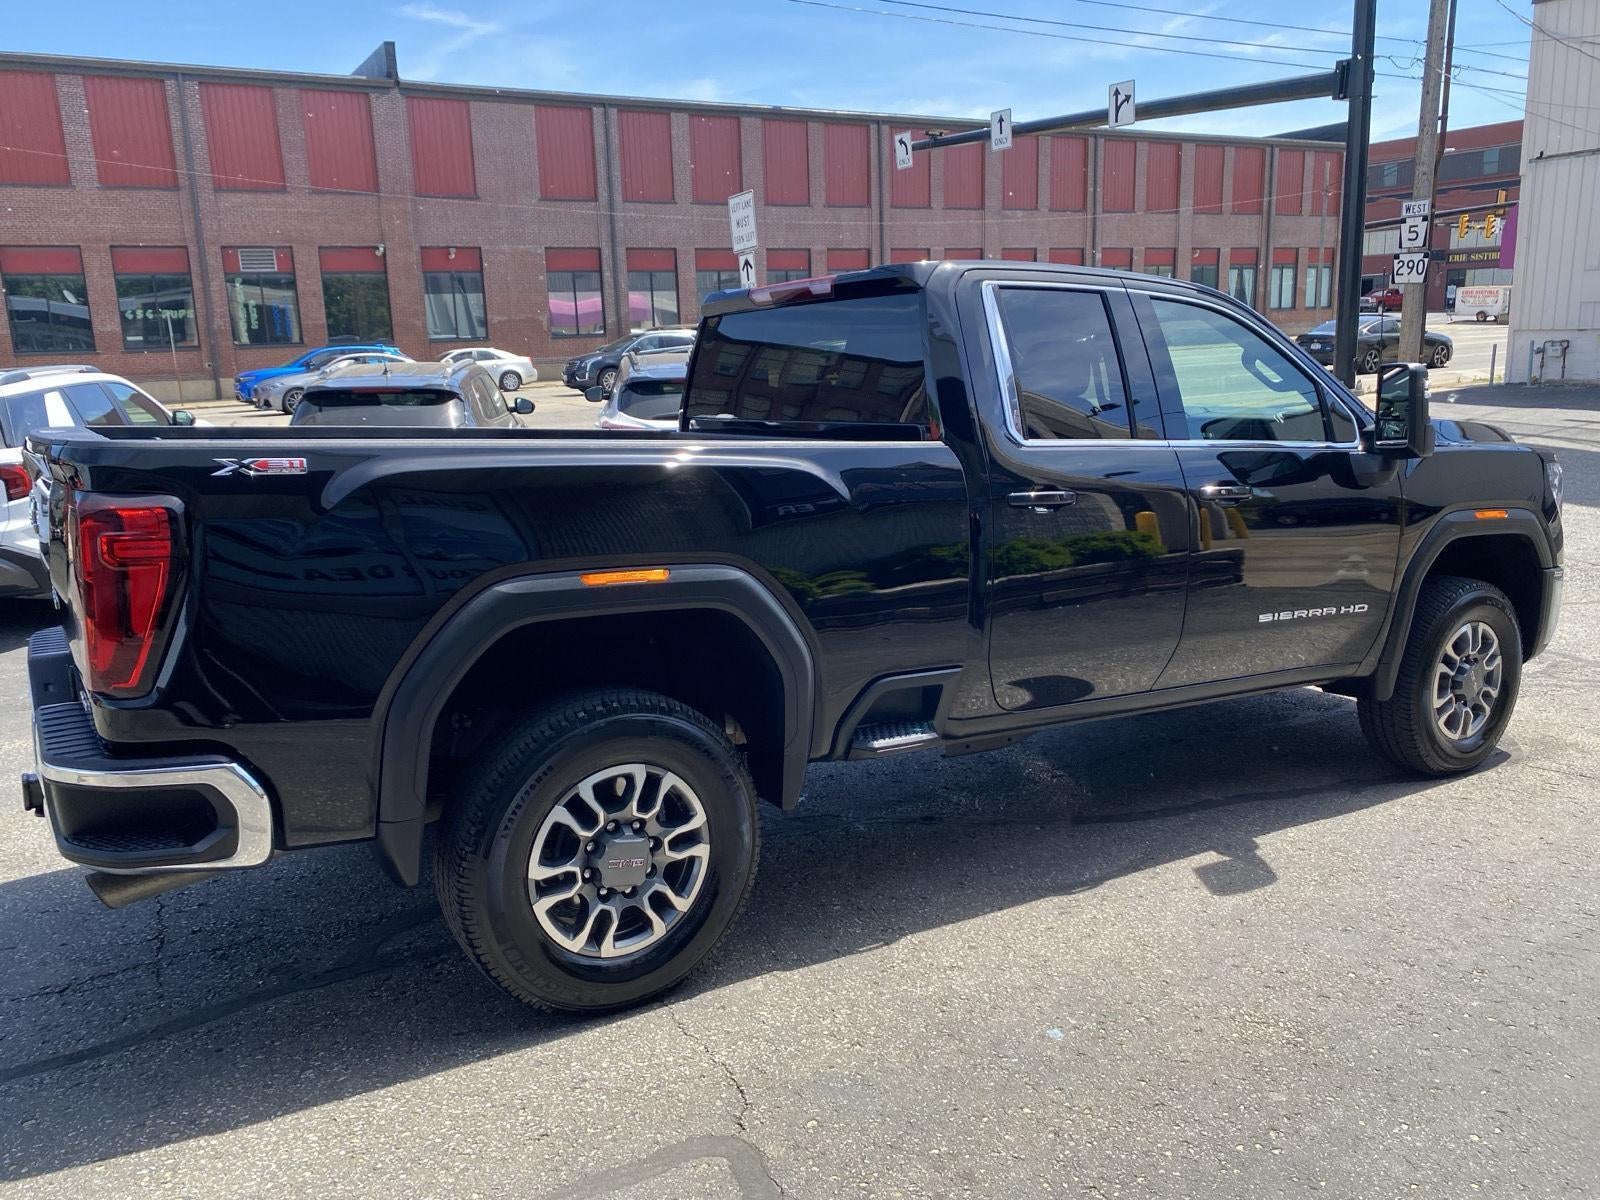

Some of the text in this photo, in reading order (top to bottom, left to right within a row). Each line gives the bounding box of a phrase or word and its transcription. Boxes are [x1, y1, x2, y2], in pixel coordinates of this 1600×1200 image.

[994, 137, 1008, 146] ONLY
[898, 157, 911, 166] ONLY
[1405, 203, 1426, 214] WEST
[736, 215, 750, 229] MUST
[1407, 224, 1419, 242] 5
[1395, 259, 1426, 276] 290
[1258, 603, 1369, 623] SIERRA HD
